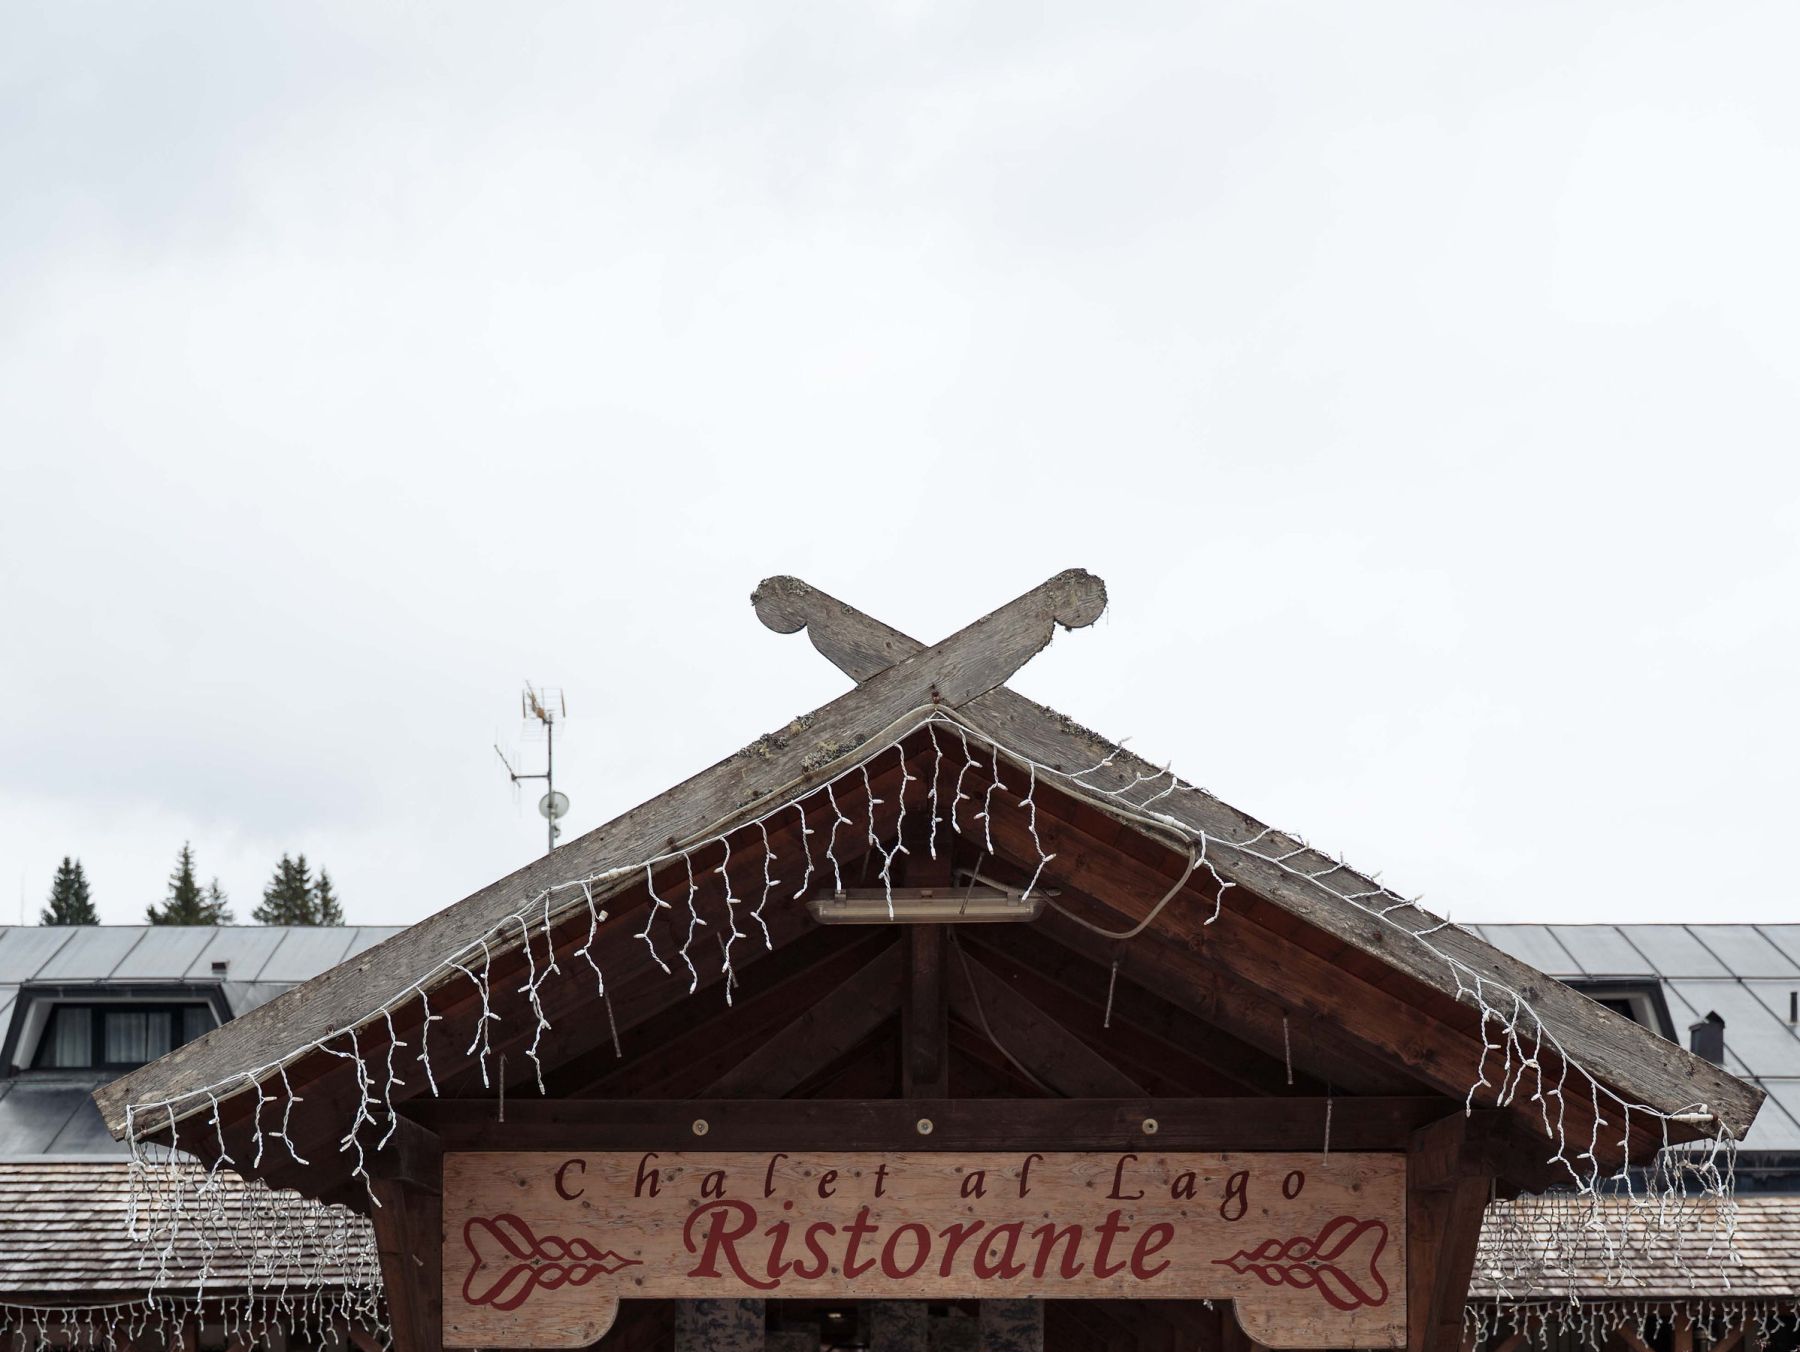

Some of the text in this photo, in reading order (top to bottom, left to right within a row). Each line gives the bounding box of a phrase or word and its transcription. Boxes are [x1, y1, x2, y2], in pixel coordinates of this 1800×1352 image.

[556, 1153, 1305, 1222] Chalet al Lago
[683, 1200, 1175, 1290] Ristorante
